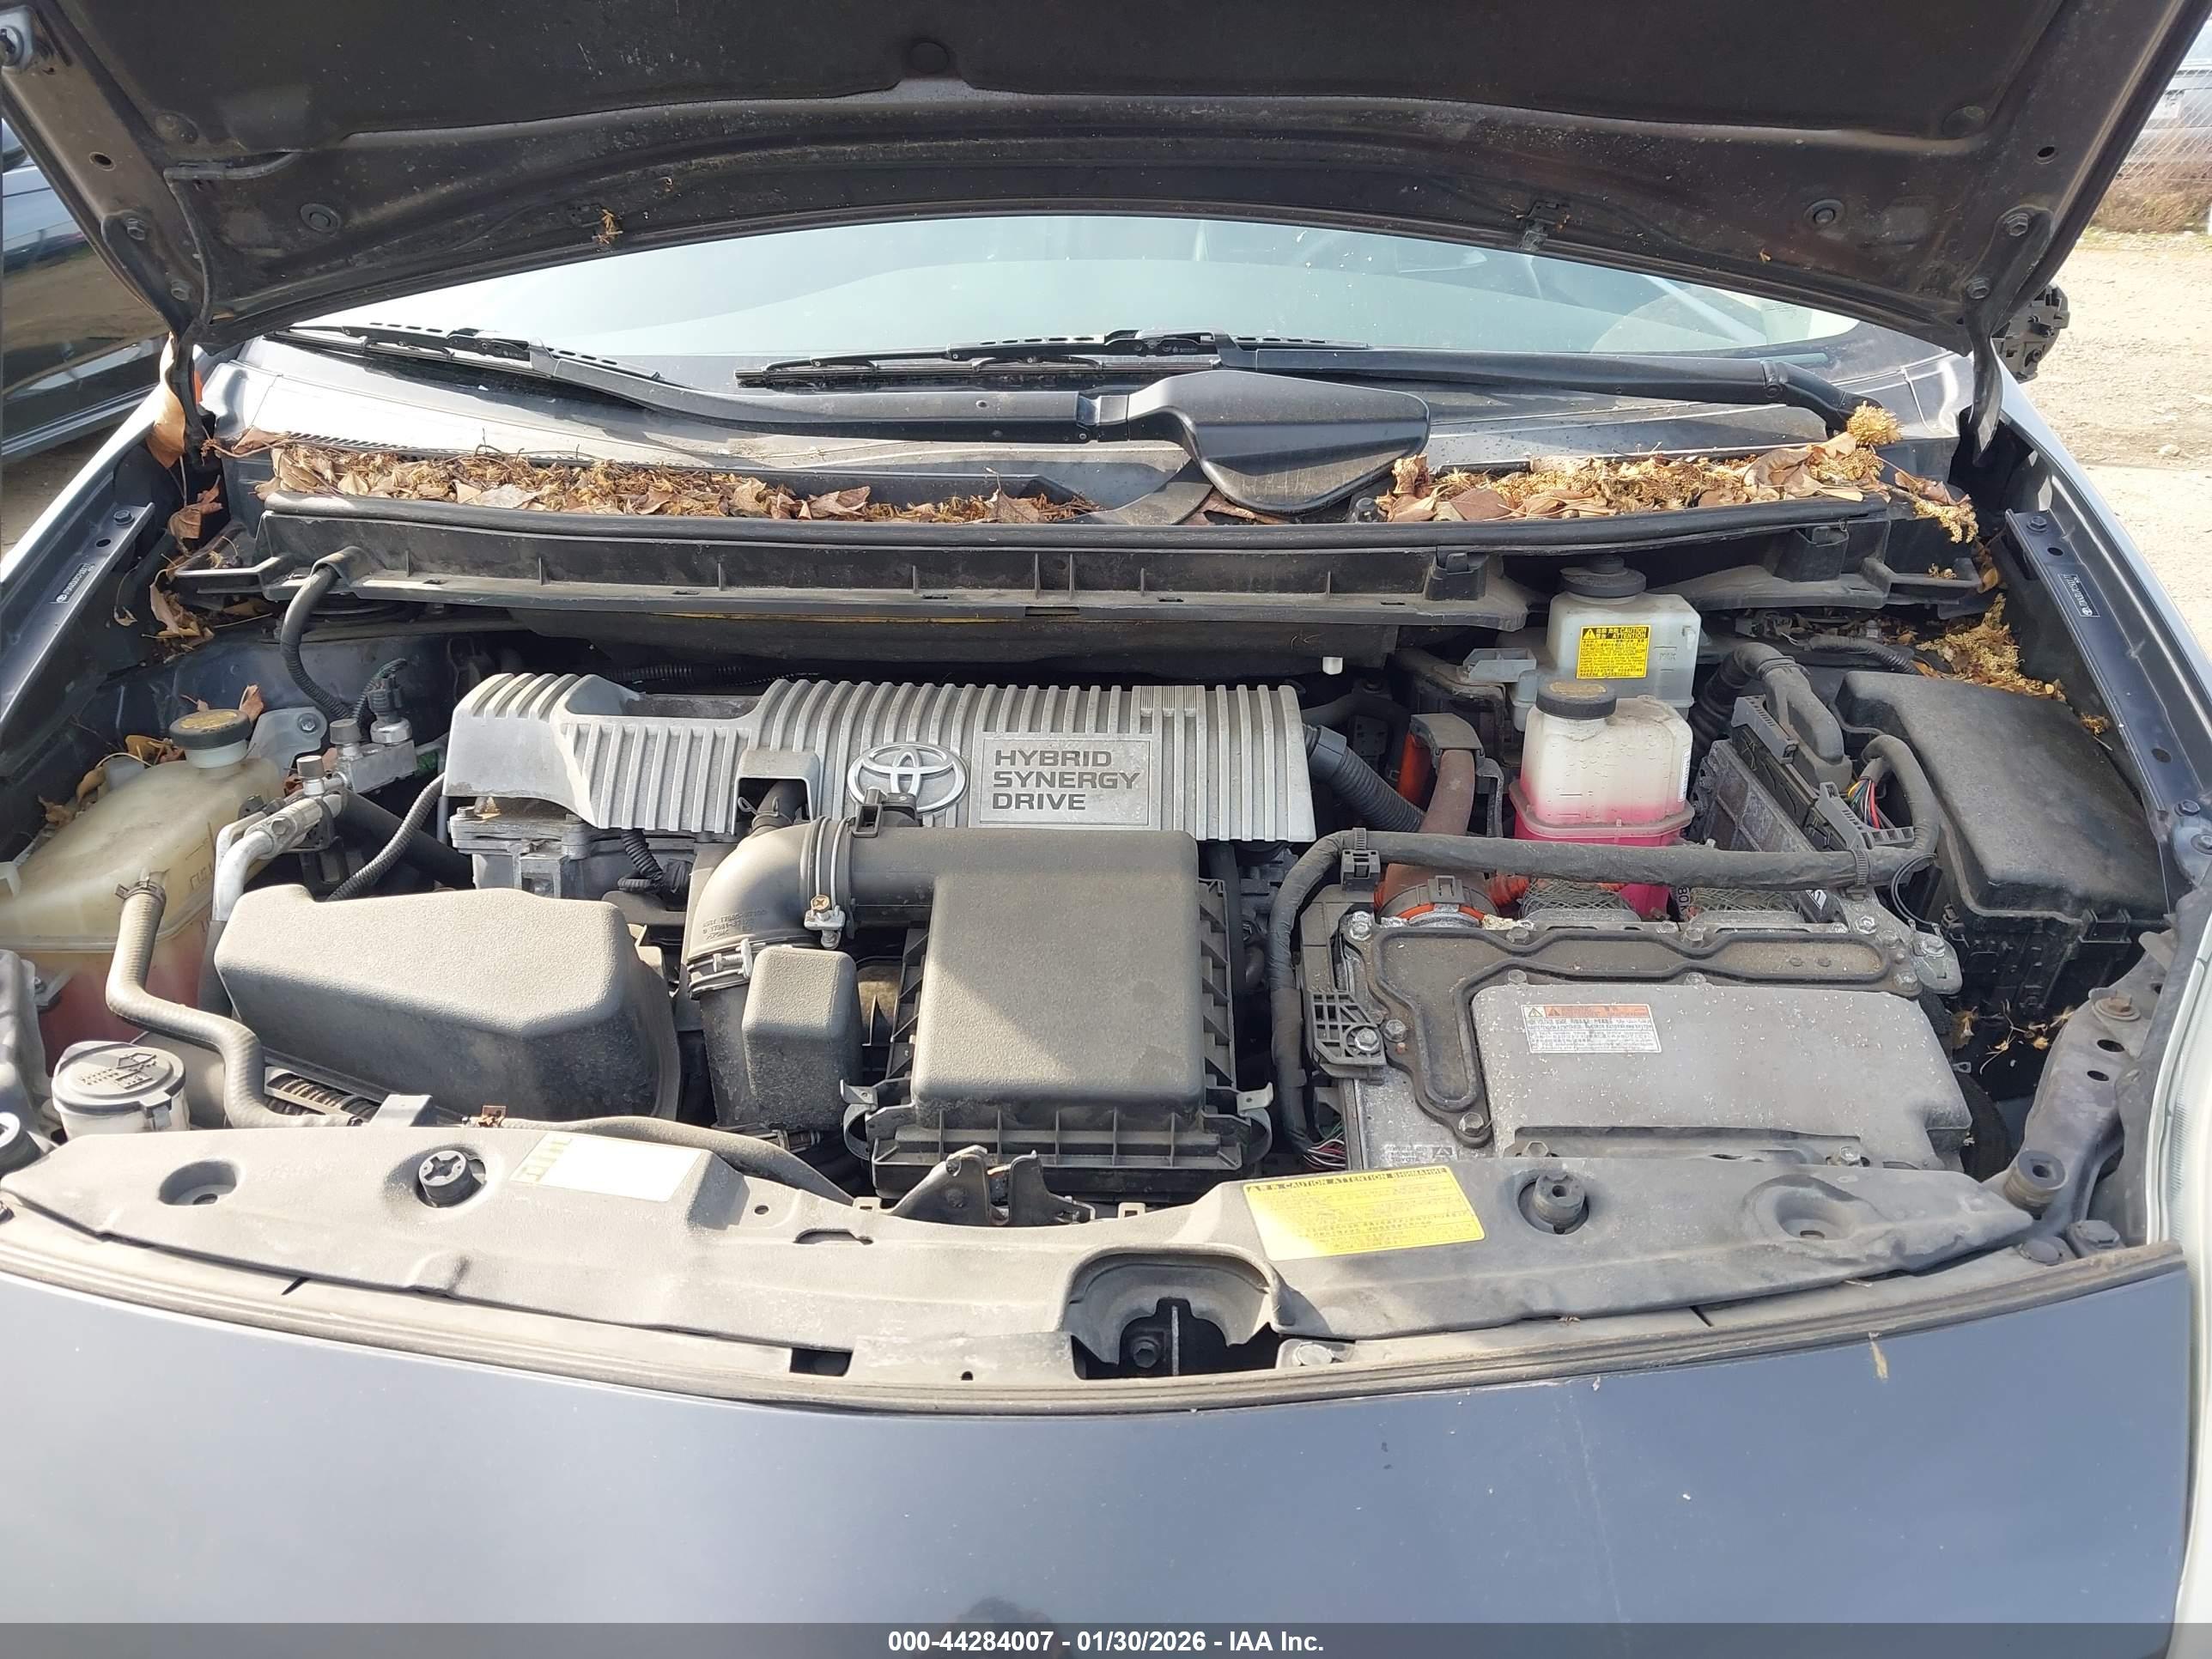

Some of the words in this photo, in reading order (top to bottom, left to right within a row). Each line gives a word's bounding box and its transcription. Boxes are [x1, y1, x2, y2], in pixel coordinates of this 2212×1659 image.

[995, 750, 1112, 767] HYBRID
[993, 771, 1141, 789] SYNERGY
[992, 793, 1086, 810] DRIVE
[1285, 1179, 1326, 1189] CAUTION
[1334, 1173, 1385, 1184] ATTENTION
